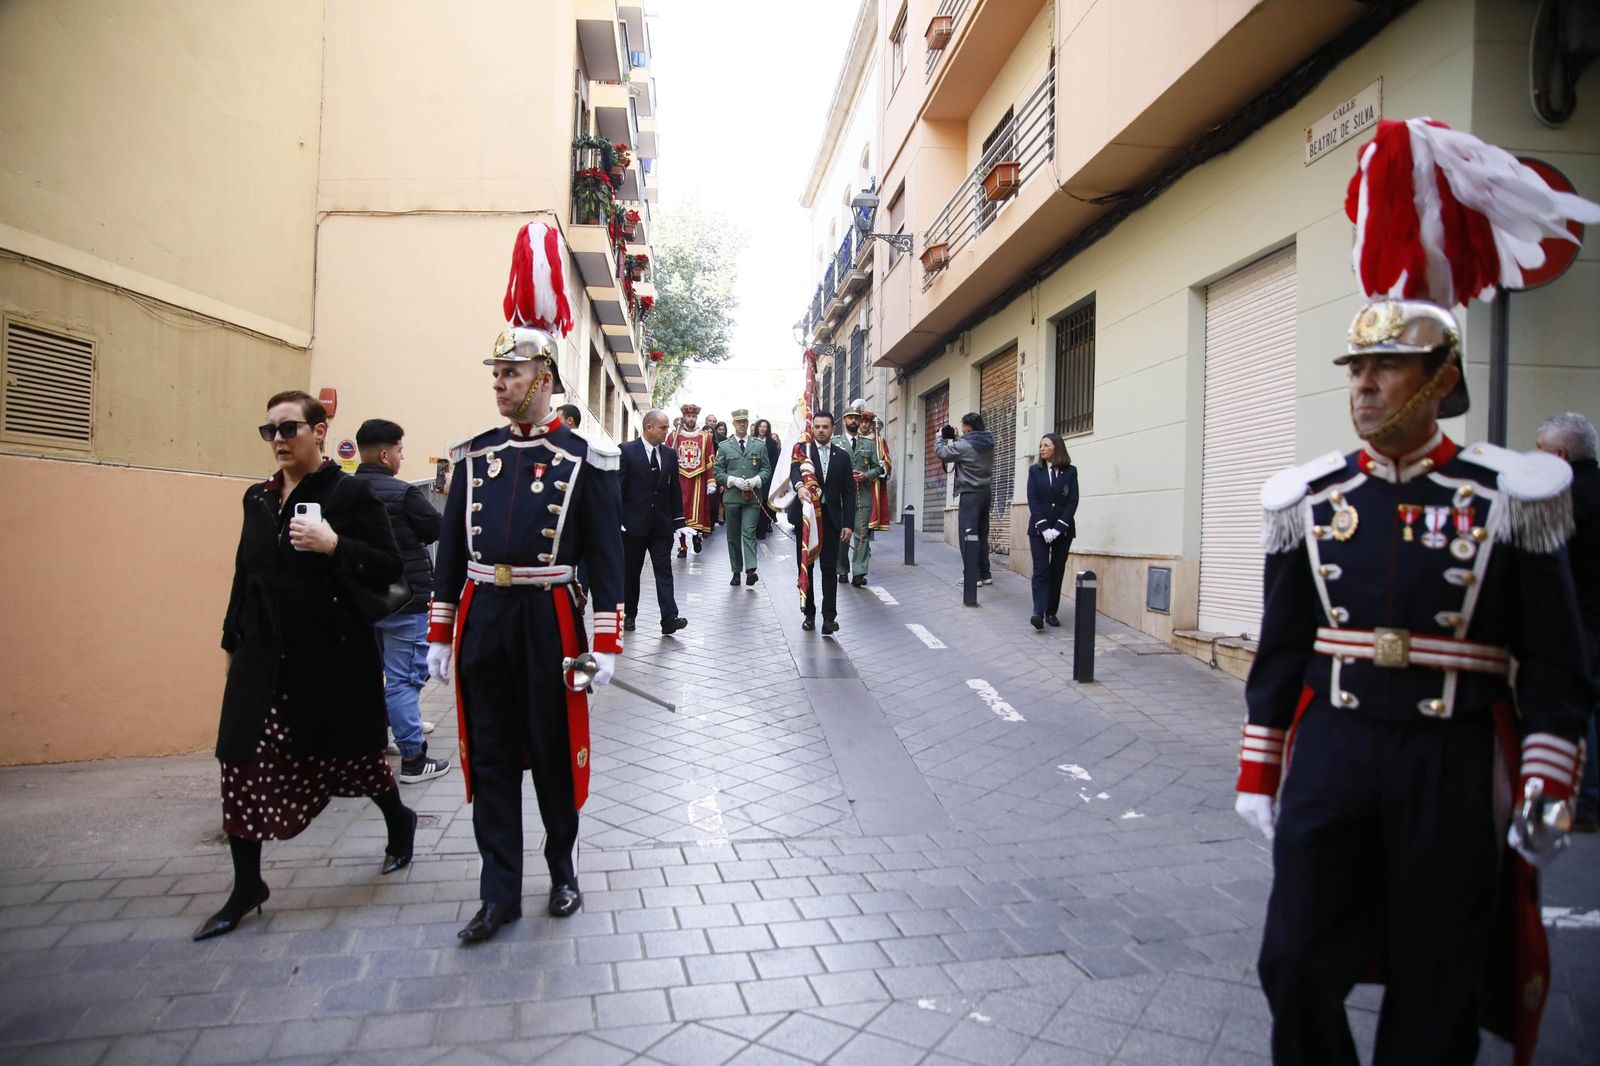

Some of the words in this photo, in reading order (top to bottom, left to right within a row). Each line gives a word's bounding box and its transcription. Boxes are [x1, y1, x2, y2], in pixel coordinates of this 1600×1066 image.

[1332, 98, 1356, 121] CALLE
[1309, 127, 1337, 158] BEATRIZ
[1340, 119, 1350, 139] DE
[1353, 104, 1374, 130] SILVA
